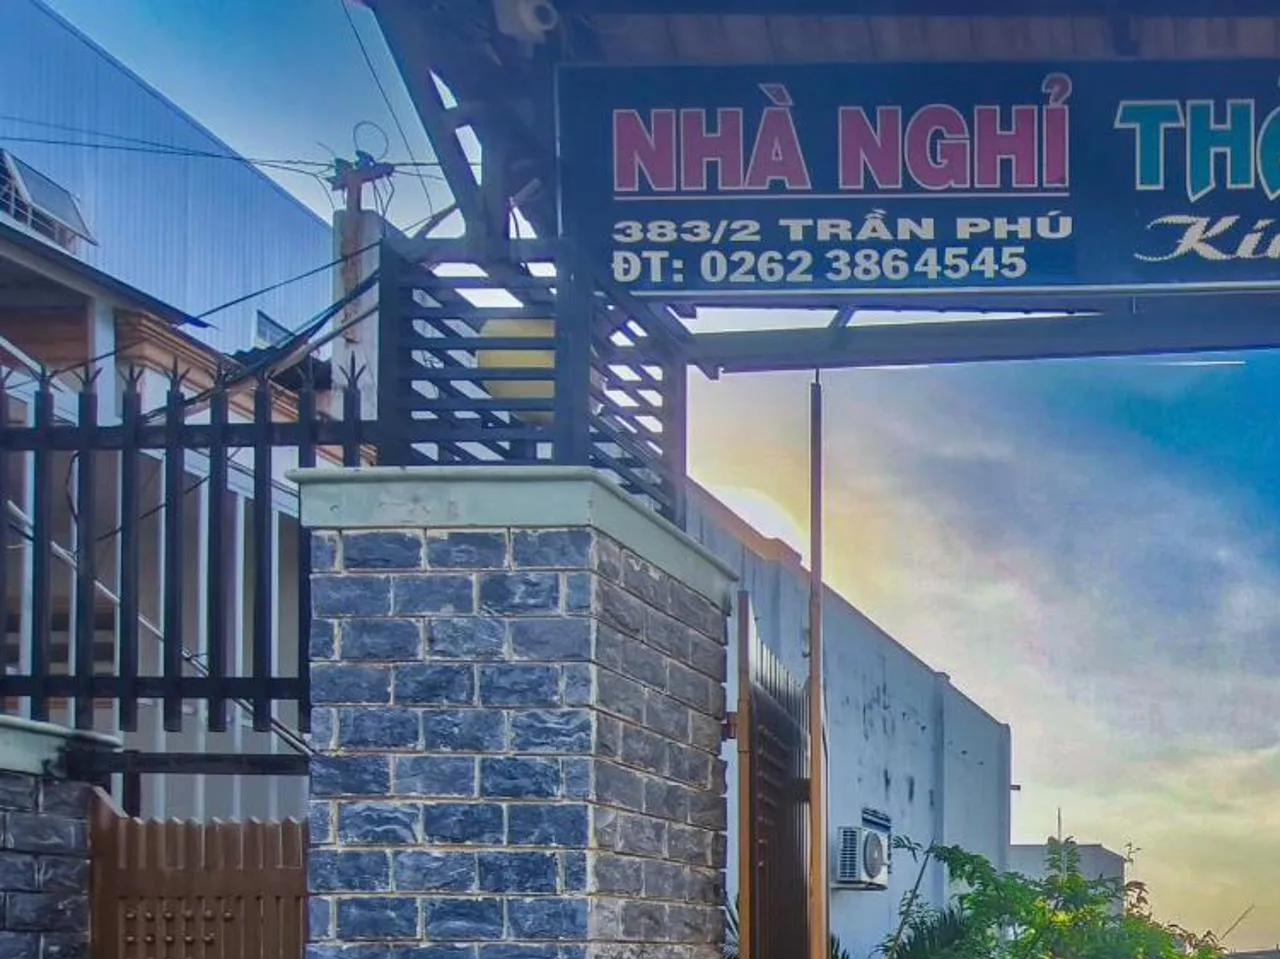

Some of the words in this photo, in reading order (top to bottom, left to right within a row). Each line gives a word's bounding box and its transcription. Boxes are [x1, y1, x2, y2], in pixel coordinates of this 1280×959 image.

[612, 83, 811, 192] NHÀ
[838, 72, 1070, 190] NGHỈ
[612, 219, 761, 244] 383/2
[779, 208, 935, 241] TRẦN
[957, 210, 1074, 240] PHÚ
[610, 250, 684, 283] ĐT:
[700, 250, 813, 283] 0262
